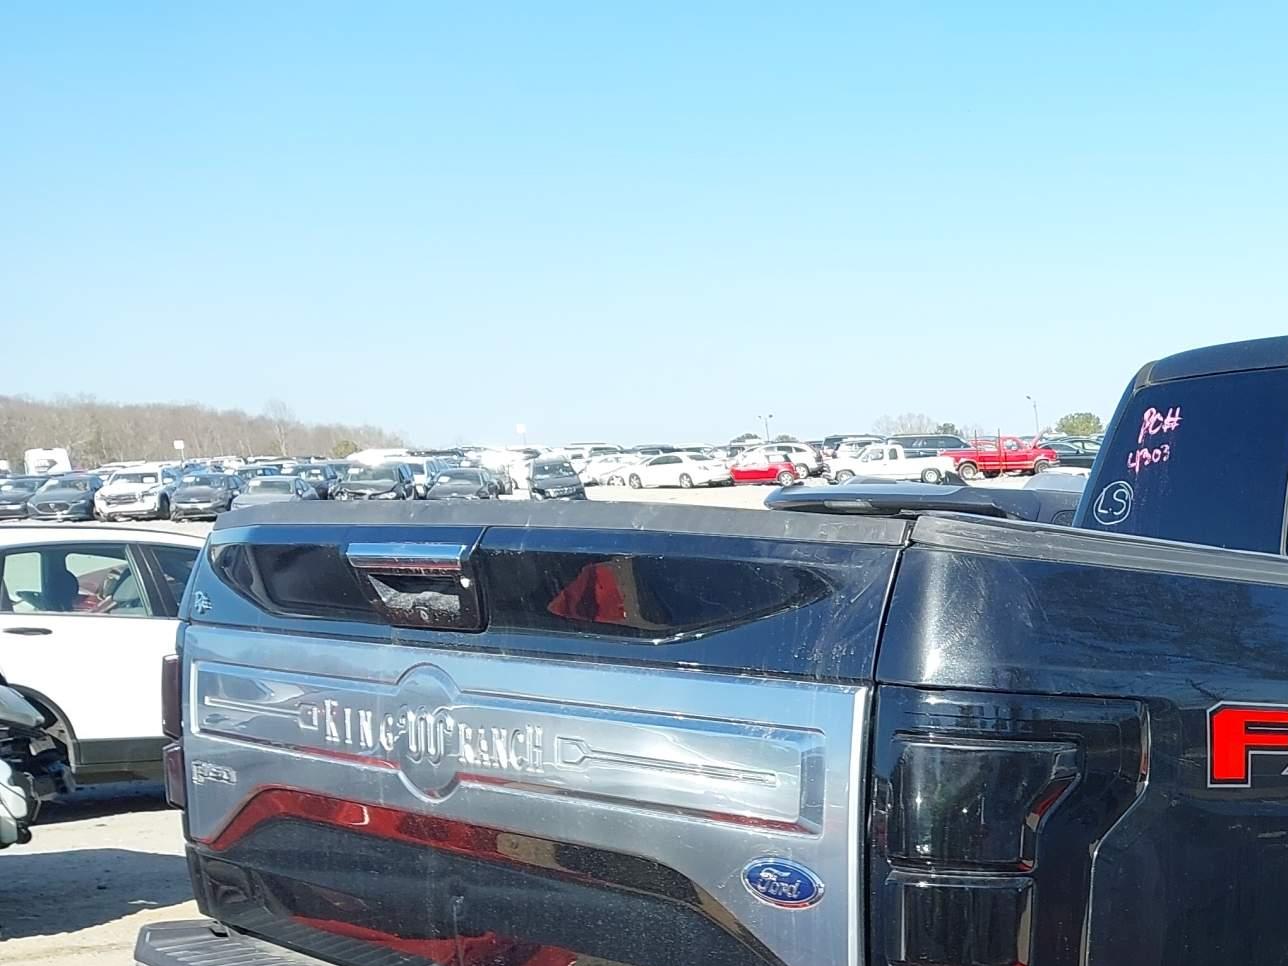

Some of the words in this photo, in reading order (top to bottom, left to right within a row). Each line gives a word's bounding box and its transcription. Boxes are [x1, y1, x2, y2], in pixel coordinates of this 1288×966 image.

[1127, 444, 1170, 473] 4303
[324, 699, 395, 751] KING
[458, 723, 545, 774] RANCH
[756, 867, 802, 899] Ford
